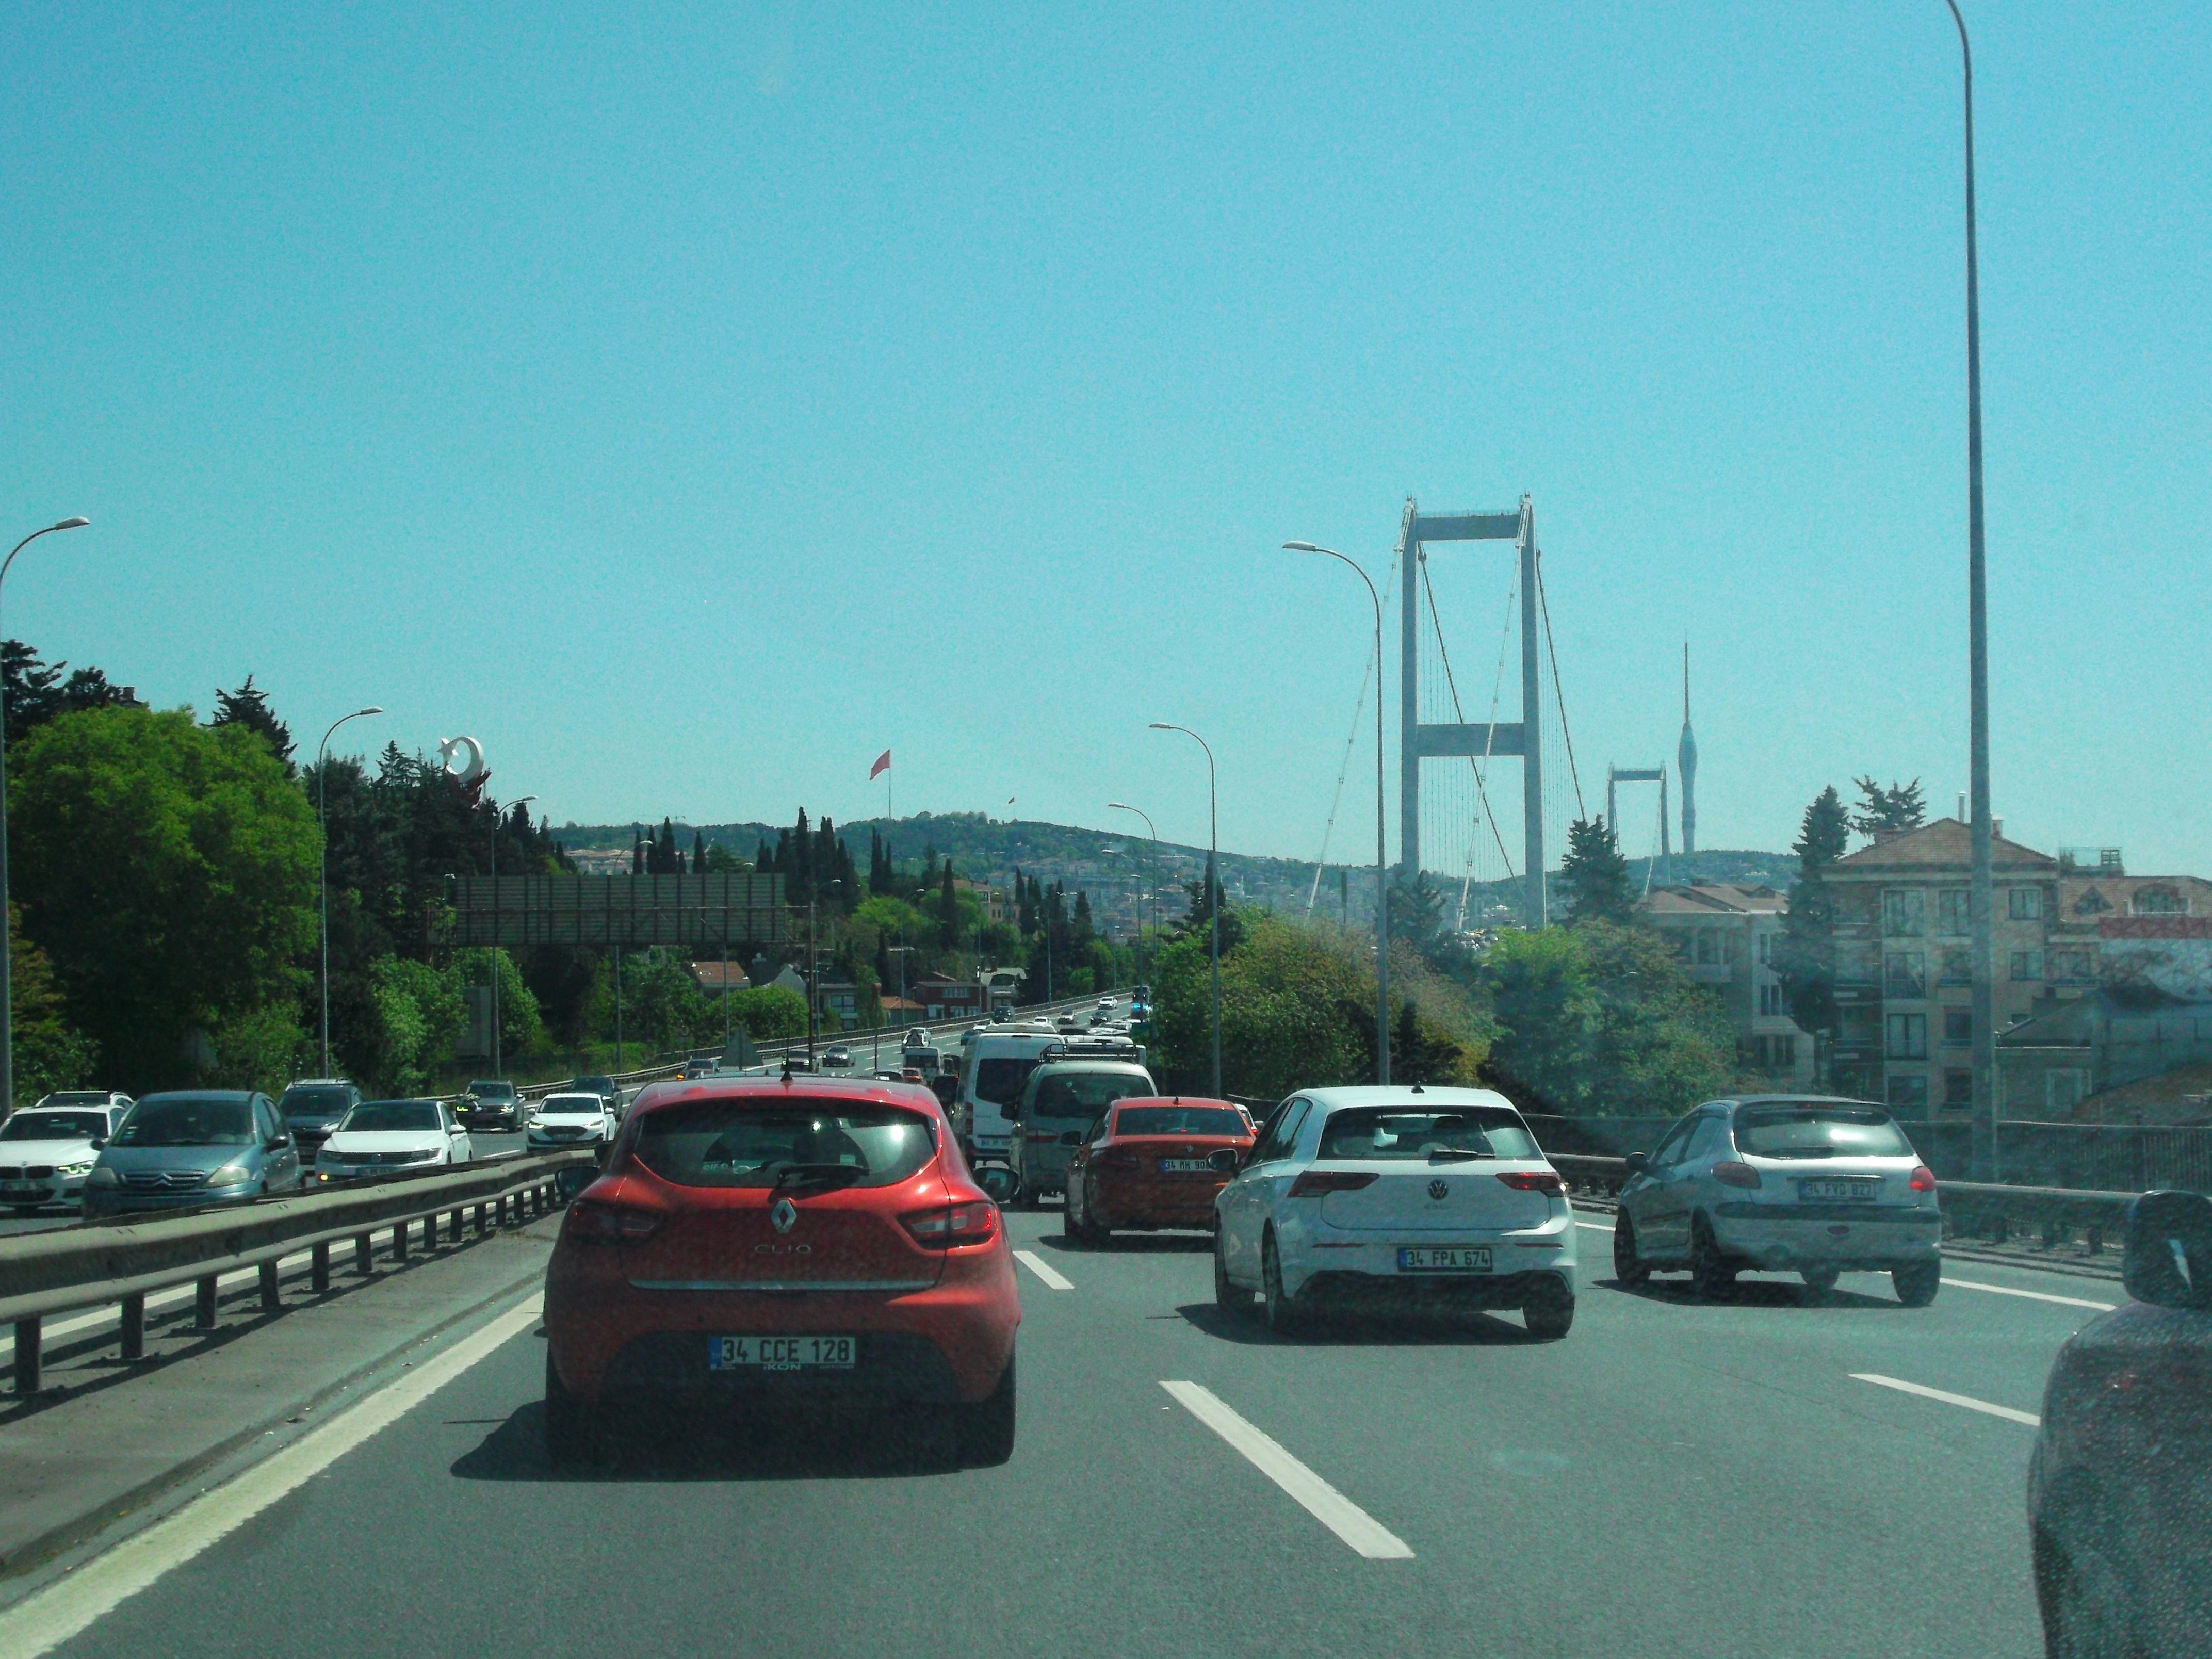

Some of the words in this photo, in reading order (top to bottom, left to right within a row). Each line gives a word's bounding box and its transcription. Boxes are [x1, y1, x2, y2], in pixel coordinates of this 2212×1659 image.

[1165, 1161, 1175, 1169] 34
[1195, 1161, 1209, 1169] 90
[1807, 1183, 1819, 1195] 34
[754, 1245, 811, 1255] CLIO
[1407, 1251, 1423, 1266] 34
[1432, 1251, 1457, 1266] FPA
[1465, 1252, 1488, 1266] 674
[723, 1340, 748, 1362] 34
[760, 1340, 800, 1362] CCE
[812, 1340, 850, 1362] 128
